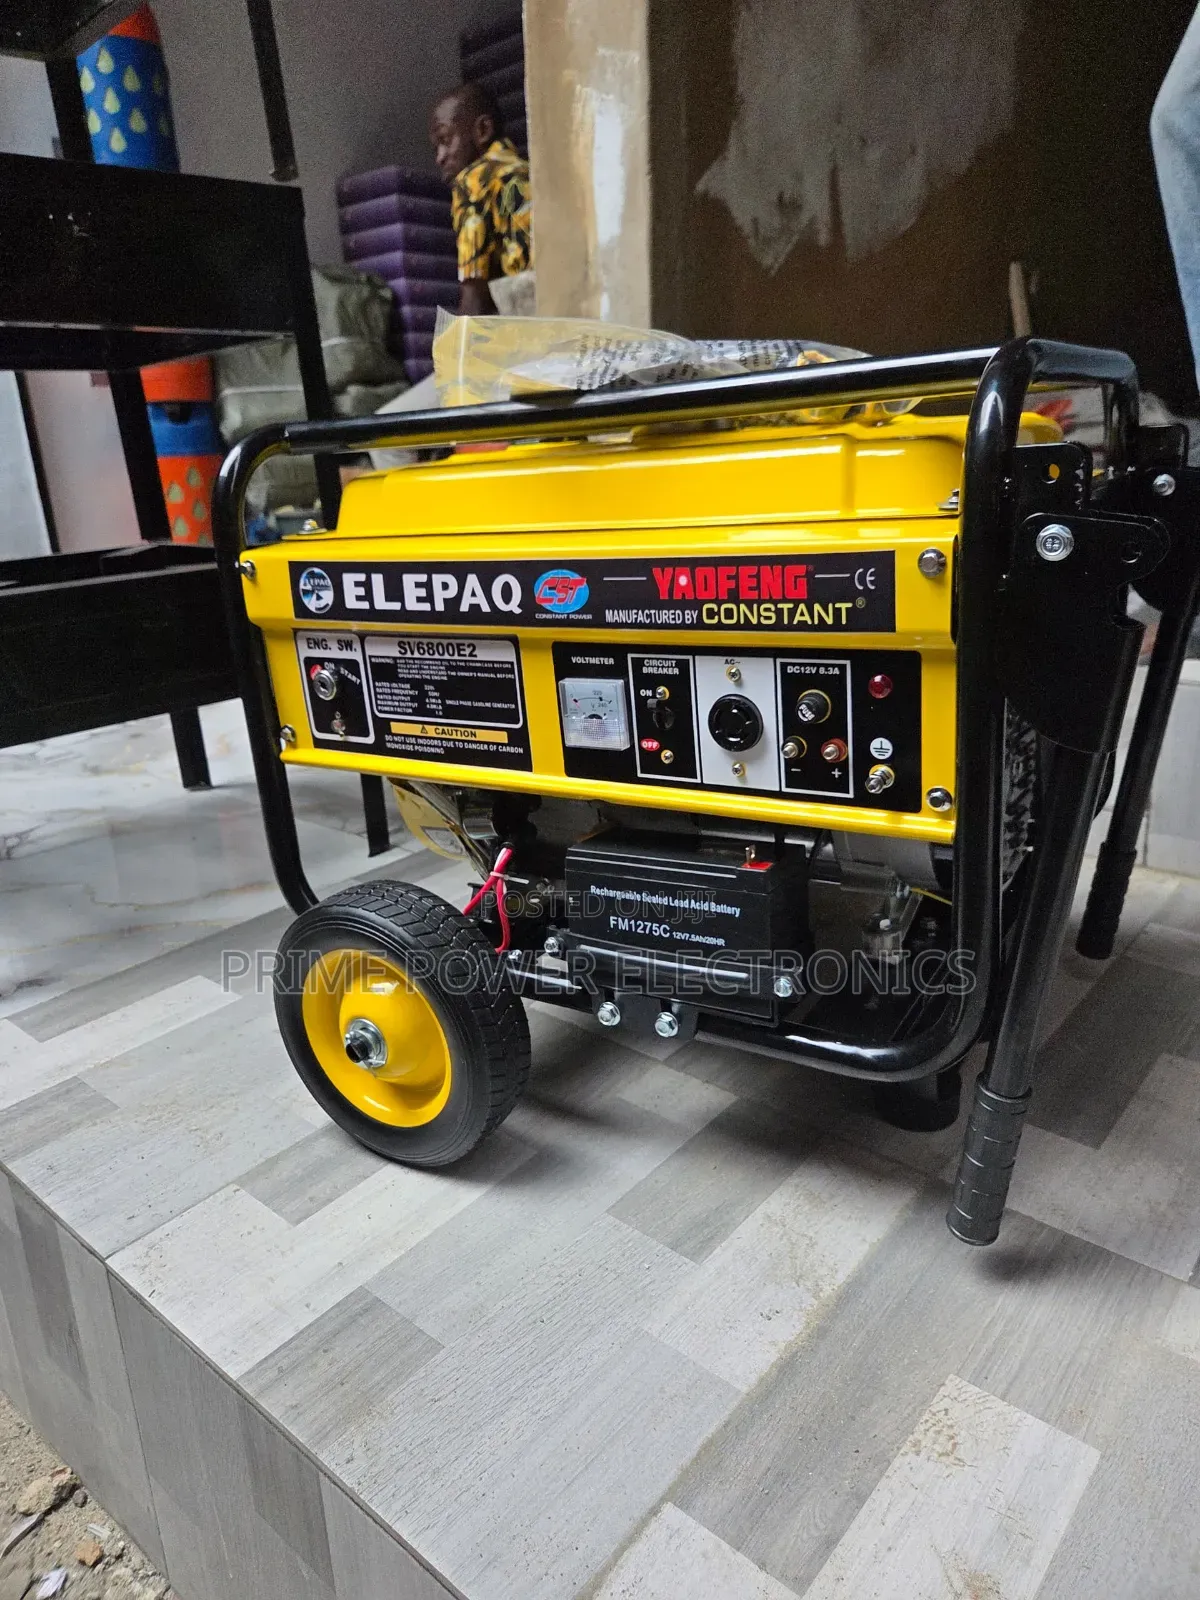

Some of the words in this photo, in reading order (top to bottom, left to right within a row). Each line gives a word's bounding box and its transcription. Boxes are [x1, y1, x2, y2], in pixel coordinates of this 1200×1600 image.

[535, 576, 587, 605] CST
[652, 565, 807, 600] YAOFENG
[342, 573, 522, 614] ELEPAQ
[605, 609, 682, 624] MANUFACTURED
[684, 609, 699, 624] BY
[702, 603, 853, 625] CONSTANT
[306, 638, 332, 650] ENG.
[337, 639, 357, 652] SW.
[397, 641, 478, 657] SV6800E2
[571, 656, 615, 665] VOLTMETER
[644, 659, 676, 667] CIRCUIT
[642, 666, 679, 675] BREAKER
[787, 665, 817, 674] DC12V
[819, 666, 840, 675] 8.3A
[640, 689, 652, 697] ON
[434, 727, 478, 739] CAUTION
[393, 735, 405, 743] NOT
[405, 736, 417, 744] USE
[417, 737, 442, 746] INDOORS
[442, 740, 454, 748] DUE
[464, 742, 488, 751] DANGER
[489, 744, 497, 752] OF
[498, 745, 524, 754] CARBON
[590, 885, 641, 902] Rechargeable
[642, 892, 668, 906] Sealed
[669, 896, 689, 909] Lead
[690, 899, 709, 911] Acid
[710, 902, 741, 917] Battery
[609, 916, 670, 938] FM1275C
